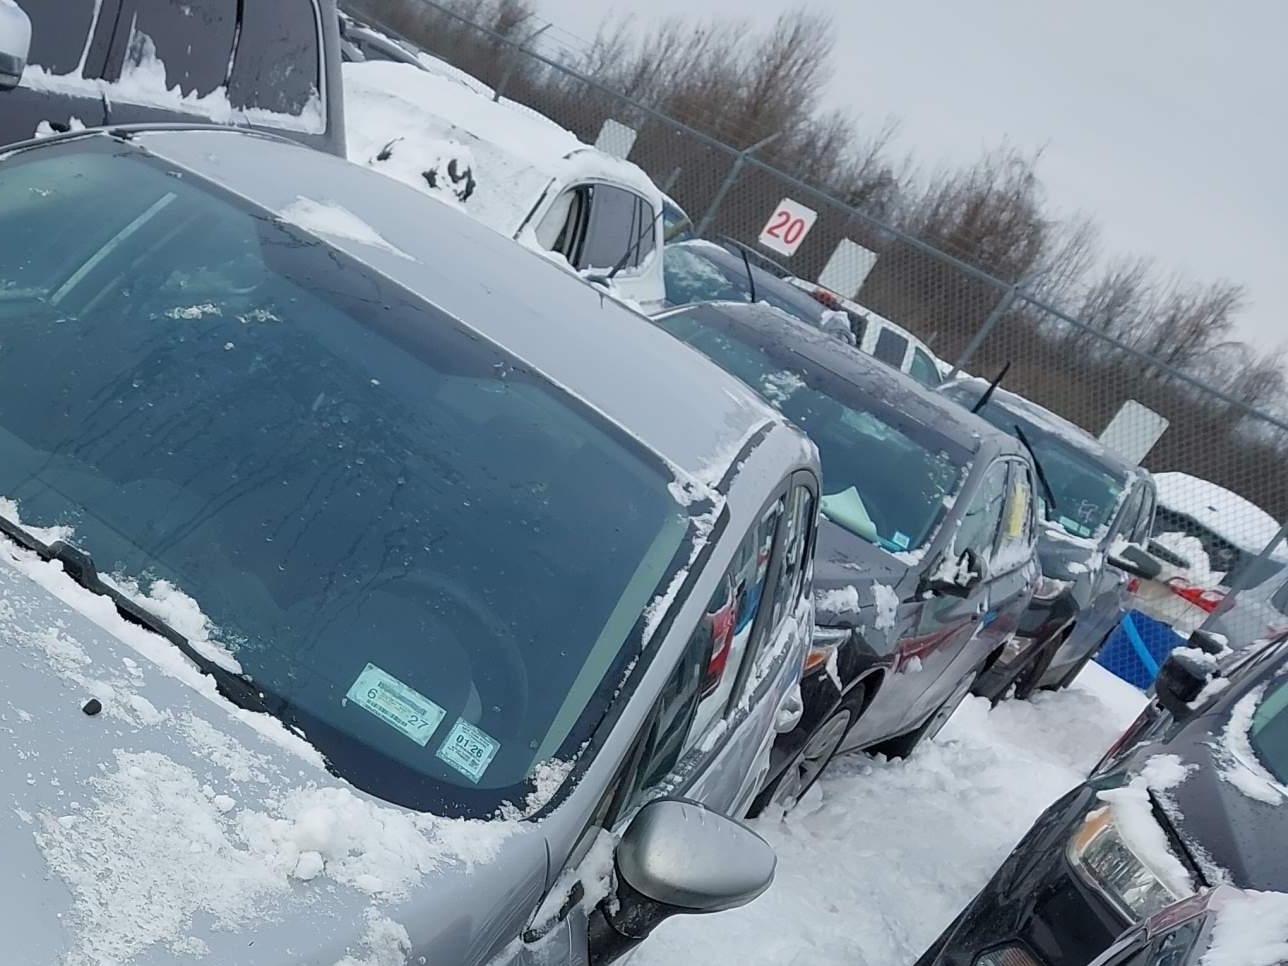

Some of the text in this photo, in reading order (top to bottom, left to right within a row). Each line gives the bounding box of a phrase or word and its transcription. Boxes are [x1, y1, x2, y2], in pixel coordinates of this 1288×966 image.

[766, 210, 805, 244] 20
[367, 688, 378, 699] 6
[407, 714, 429, 729] 27
[456, 734, 470, 747] 01
[470, 744, 484, 758] 26
